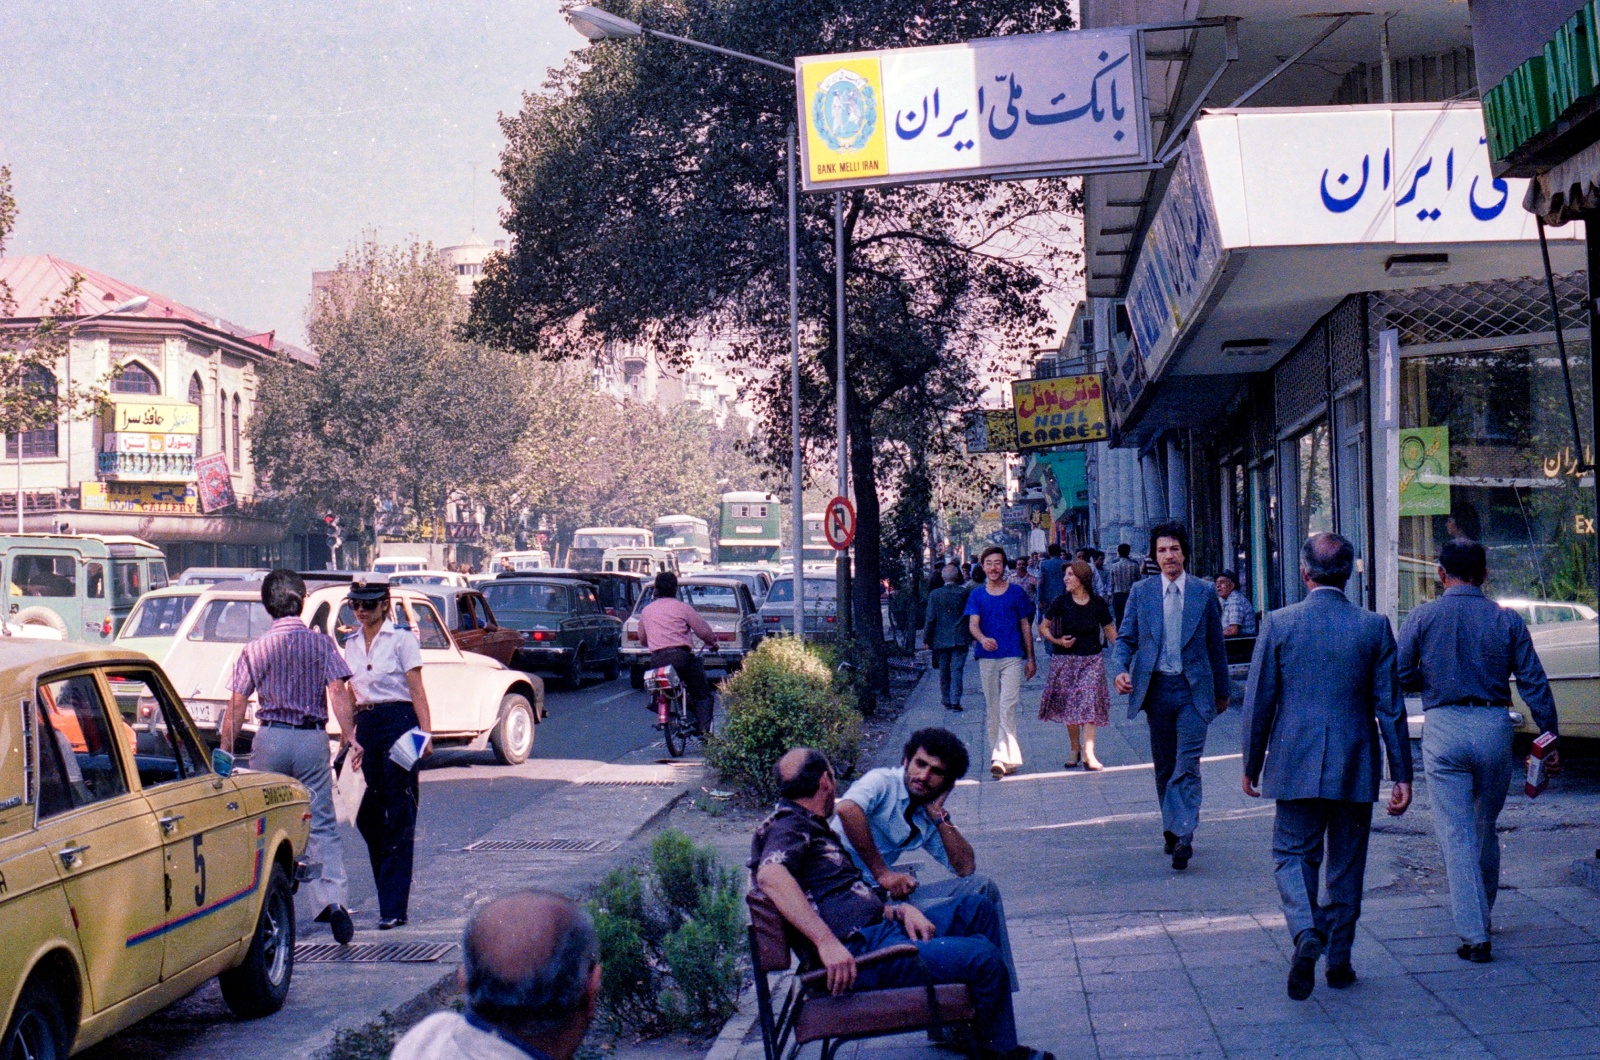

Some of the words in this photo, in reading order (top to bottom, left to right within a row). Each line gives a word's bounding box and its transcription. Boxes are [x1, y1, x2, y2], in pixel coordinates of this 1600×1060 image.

[1025, 51, 1130, 142] بانک
[896, 85, 984, 151] ایران
[817, 163, 837, 174] BANK
[839, 161, 860, 173] MELLI
[862, 160, 880, 171] IRAN
[1319, 147, 1454, 221] ایران
[122, 408, 141, 430] سرا
[142, 406, 164, 425] حافظ
[1035, 410, 1089, 428] NOEL
[1020, 422, 1105, 445] CARPET
[141, 502, 194, 512] GALLERY
[193, 832, 206, 907] 5
